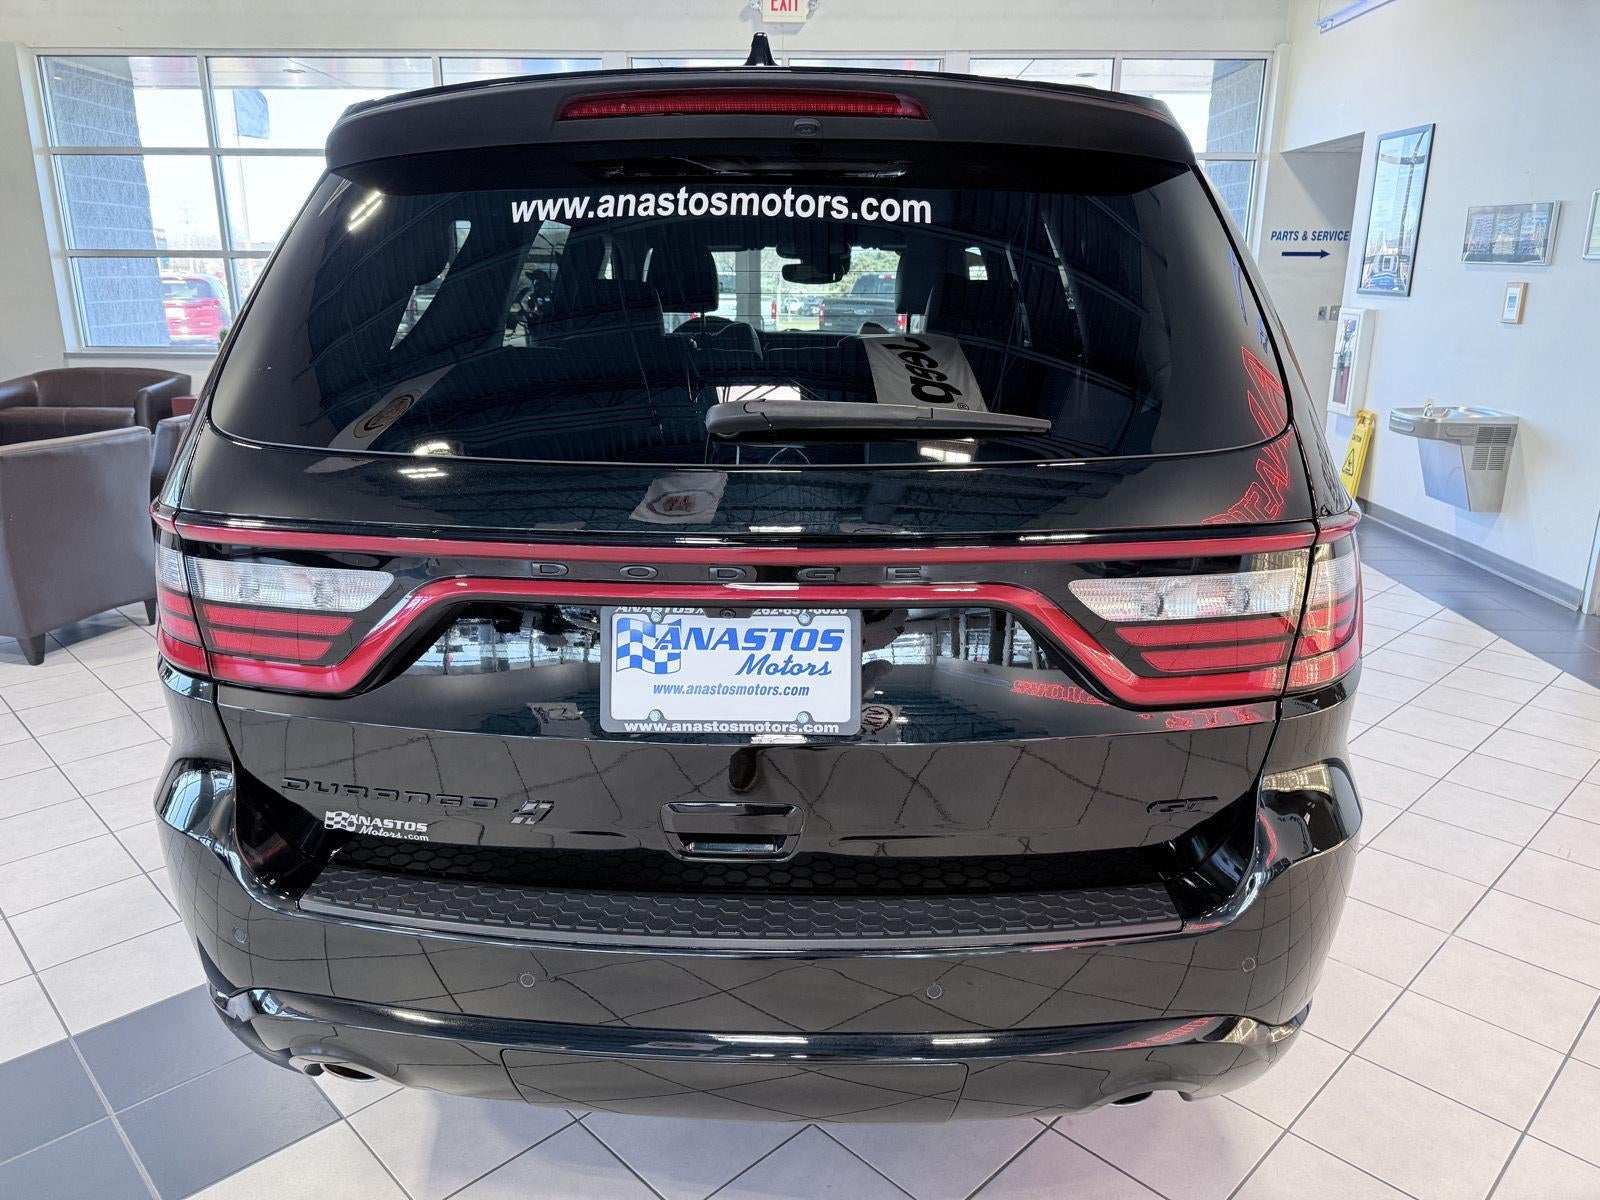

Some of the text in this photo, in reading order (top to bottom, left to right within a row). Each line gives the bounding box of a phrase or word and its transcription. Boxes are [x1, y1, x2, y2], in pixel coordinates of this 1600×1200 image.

[771, 0, 798, 11] EXIT
[511, 186, 932, 224] www.anastosmotors.com
[1270, 230, 1350, 241] PARTS & SERVICE
[531, 562, 922, 581] DODGE
[653, 627, 845, 652] ANASTOS
[735, 653, 832, 676] Motors
[653, 683, 810, 696] www.anastosmotors.com
[624, 721, 839, 734] www.anastosmotors.com
[281, 777, 498, 809] DURANGO
[346, 813, 428, 832] ANASTOS
